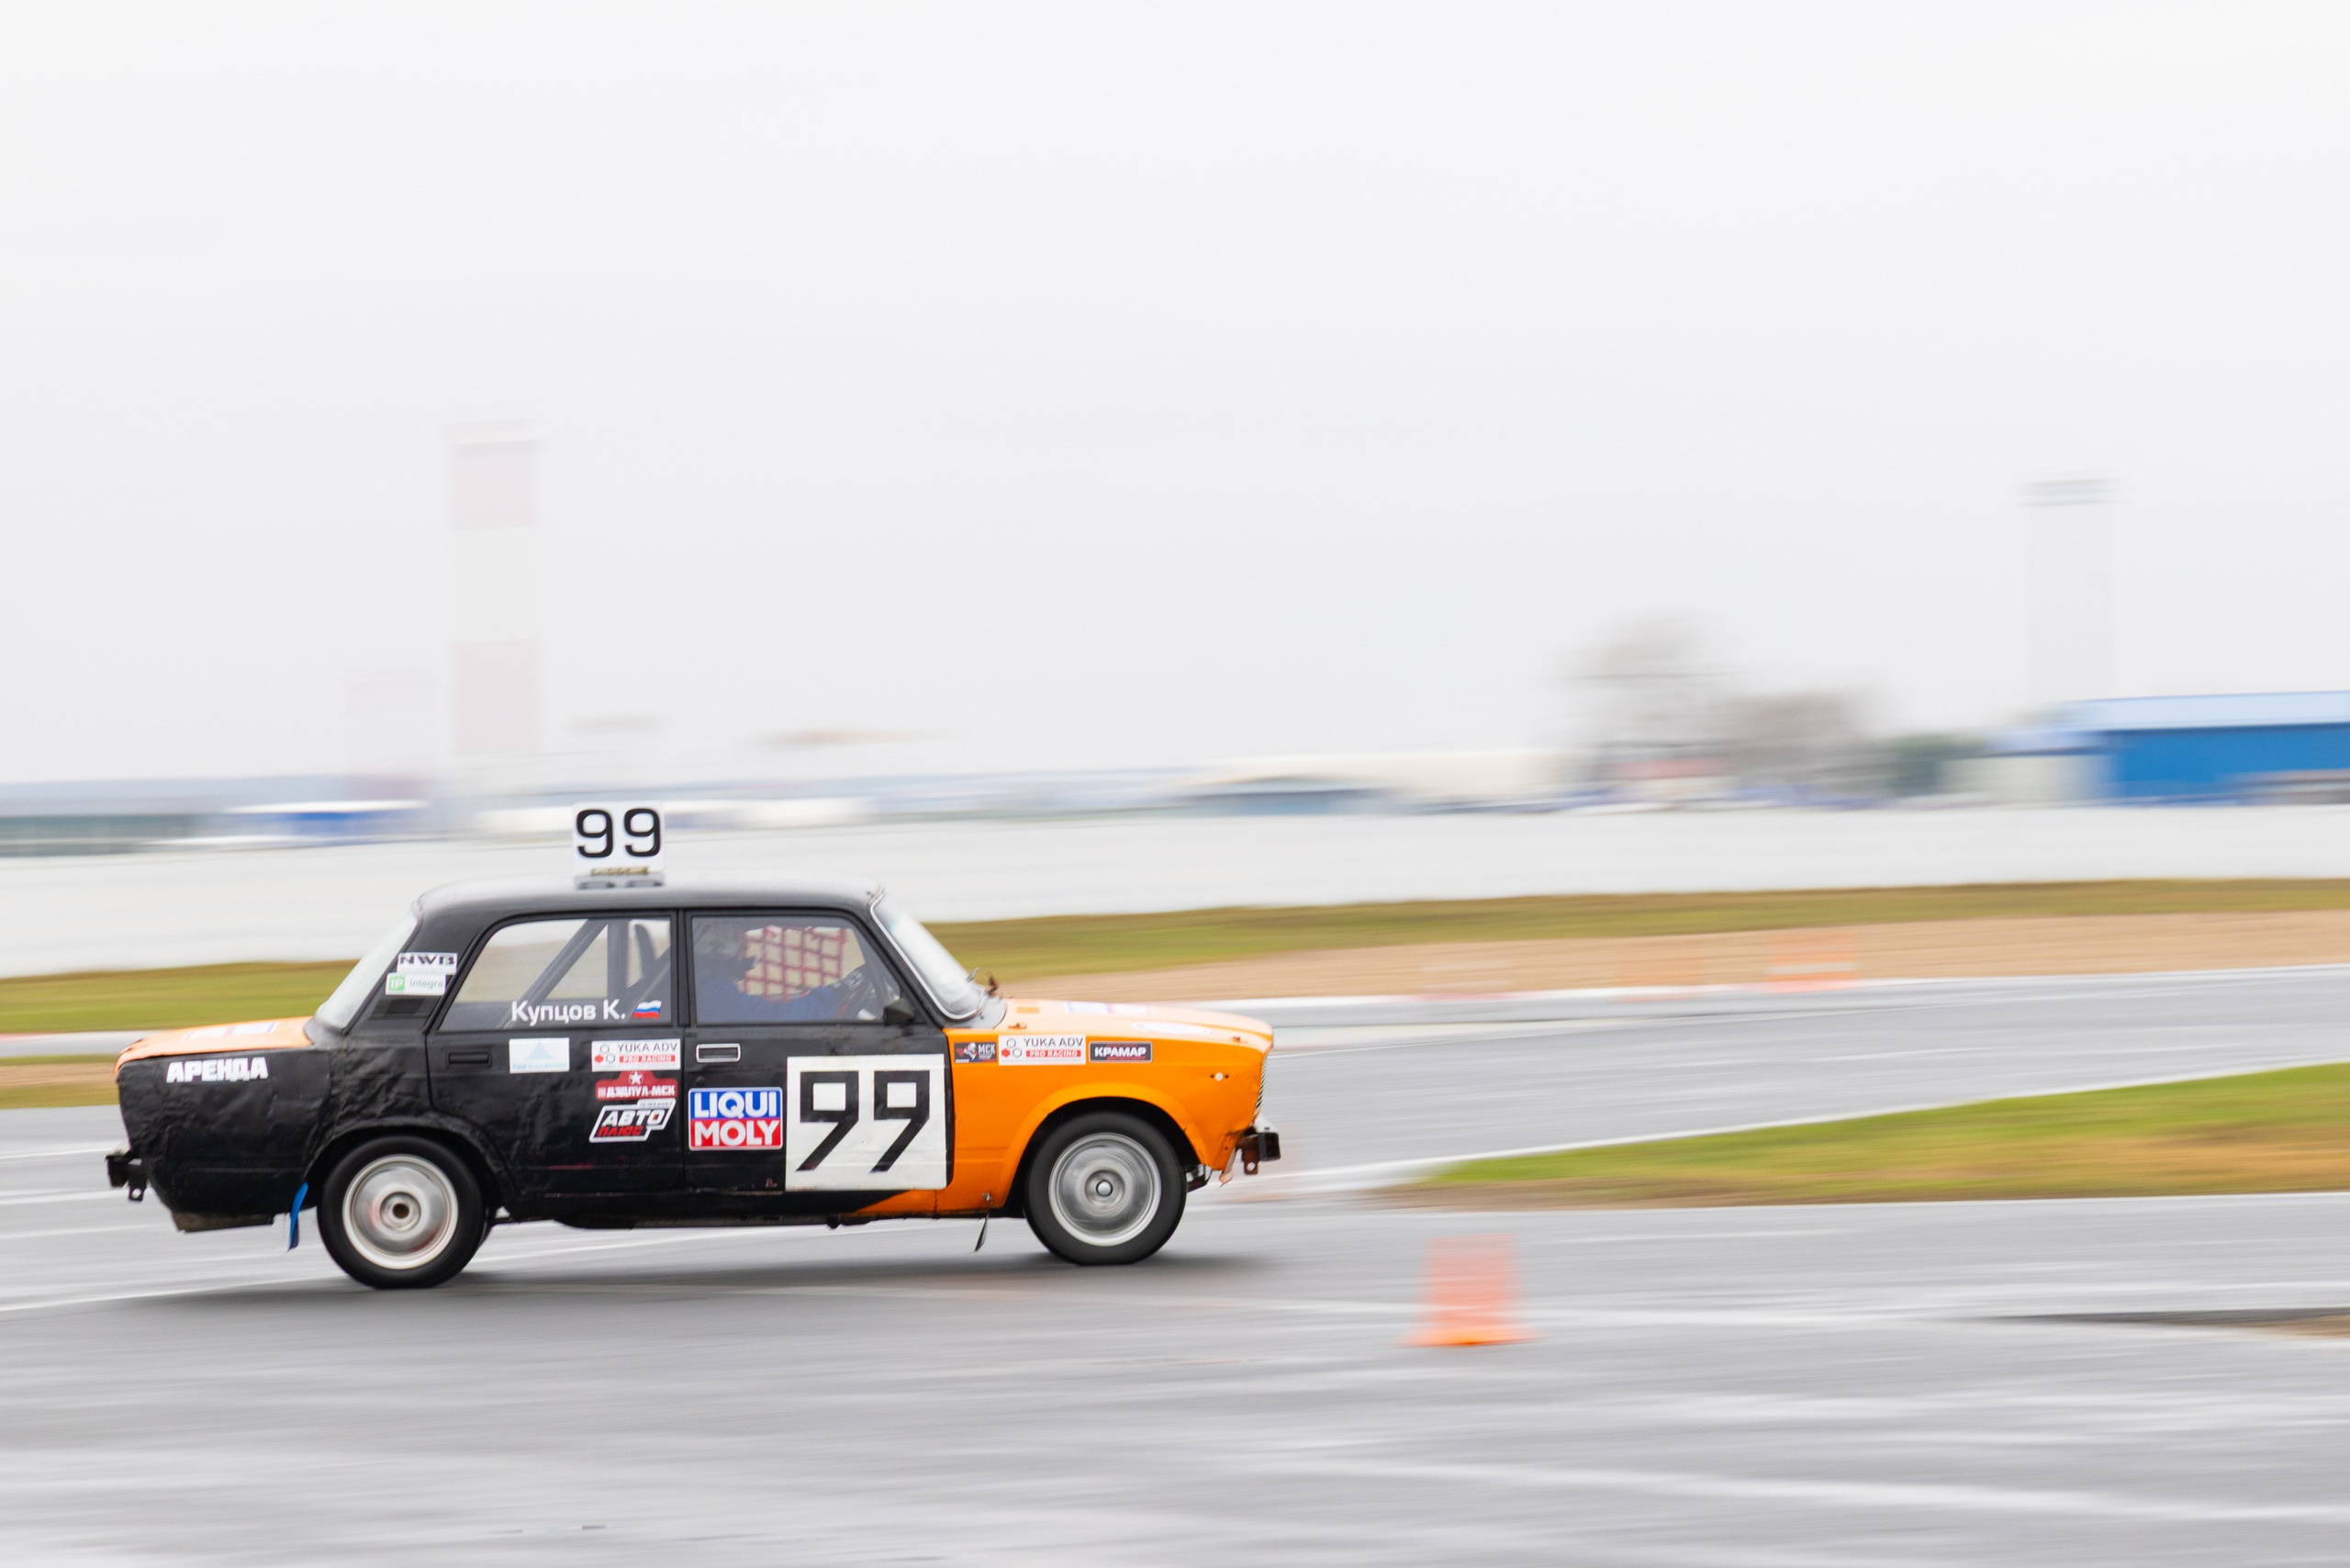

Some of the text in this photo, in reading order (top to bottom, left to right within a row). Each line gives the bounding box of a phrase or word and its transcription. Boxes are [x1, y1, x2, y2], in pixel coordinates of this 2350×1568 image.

[576, 808, 661, 858] 99
[399, 956, 454, 965] NWB
[511, 999, 626, 1026] Купцов К.
[618, 1042, 677, 1053] YUKA ADV
[1024, 1037, 1083, 1047] YUKA ADV
[1094, 1047, 1147, 1058] КРАМАР
[166, 1057, 269, 1083] АРЕНДА
[694, 1092, 777, 1119] LIQUI
[601, 1110, 666, 1126] АВТО
[795, 1070, 930, 1173] 99
[598, 1126, 643, 1137] ПЛЮС
[694, 1120, 780, 1146] MOLY
